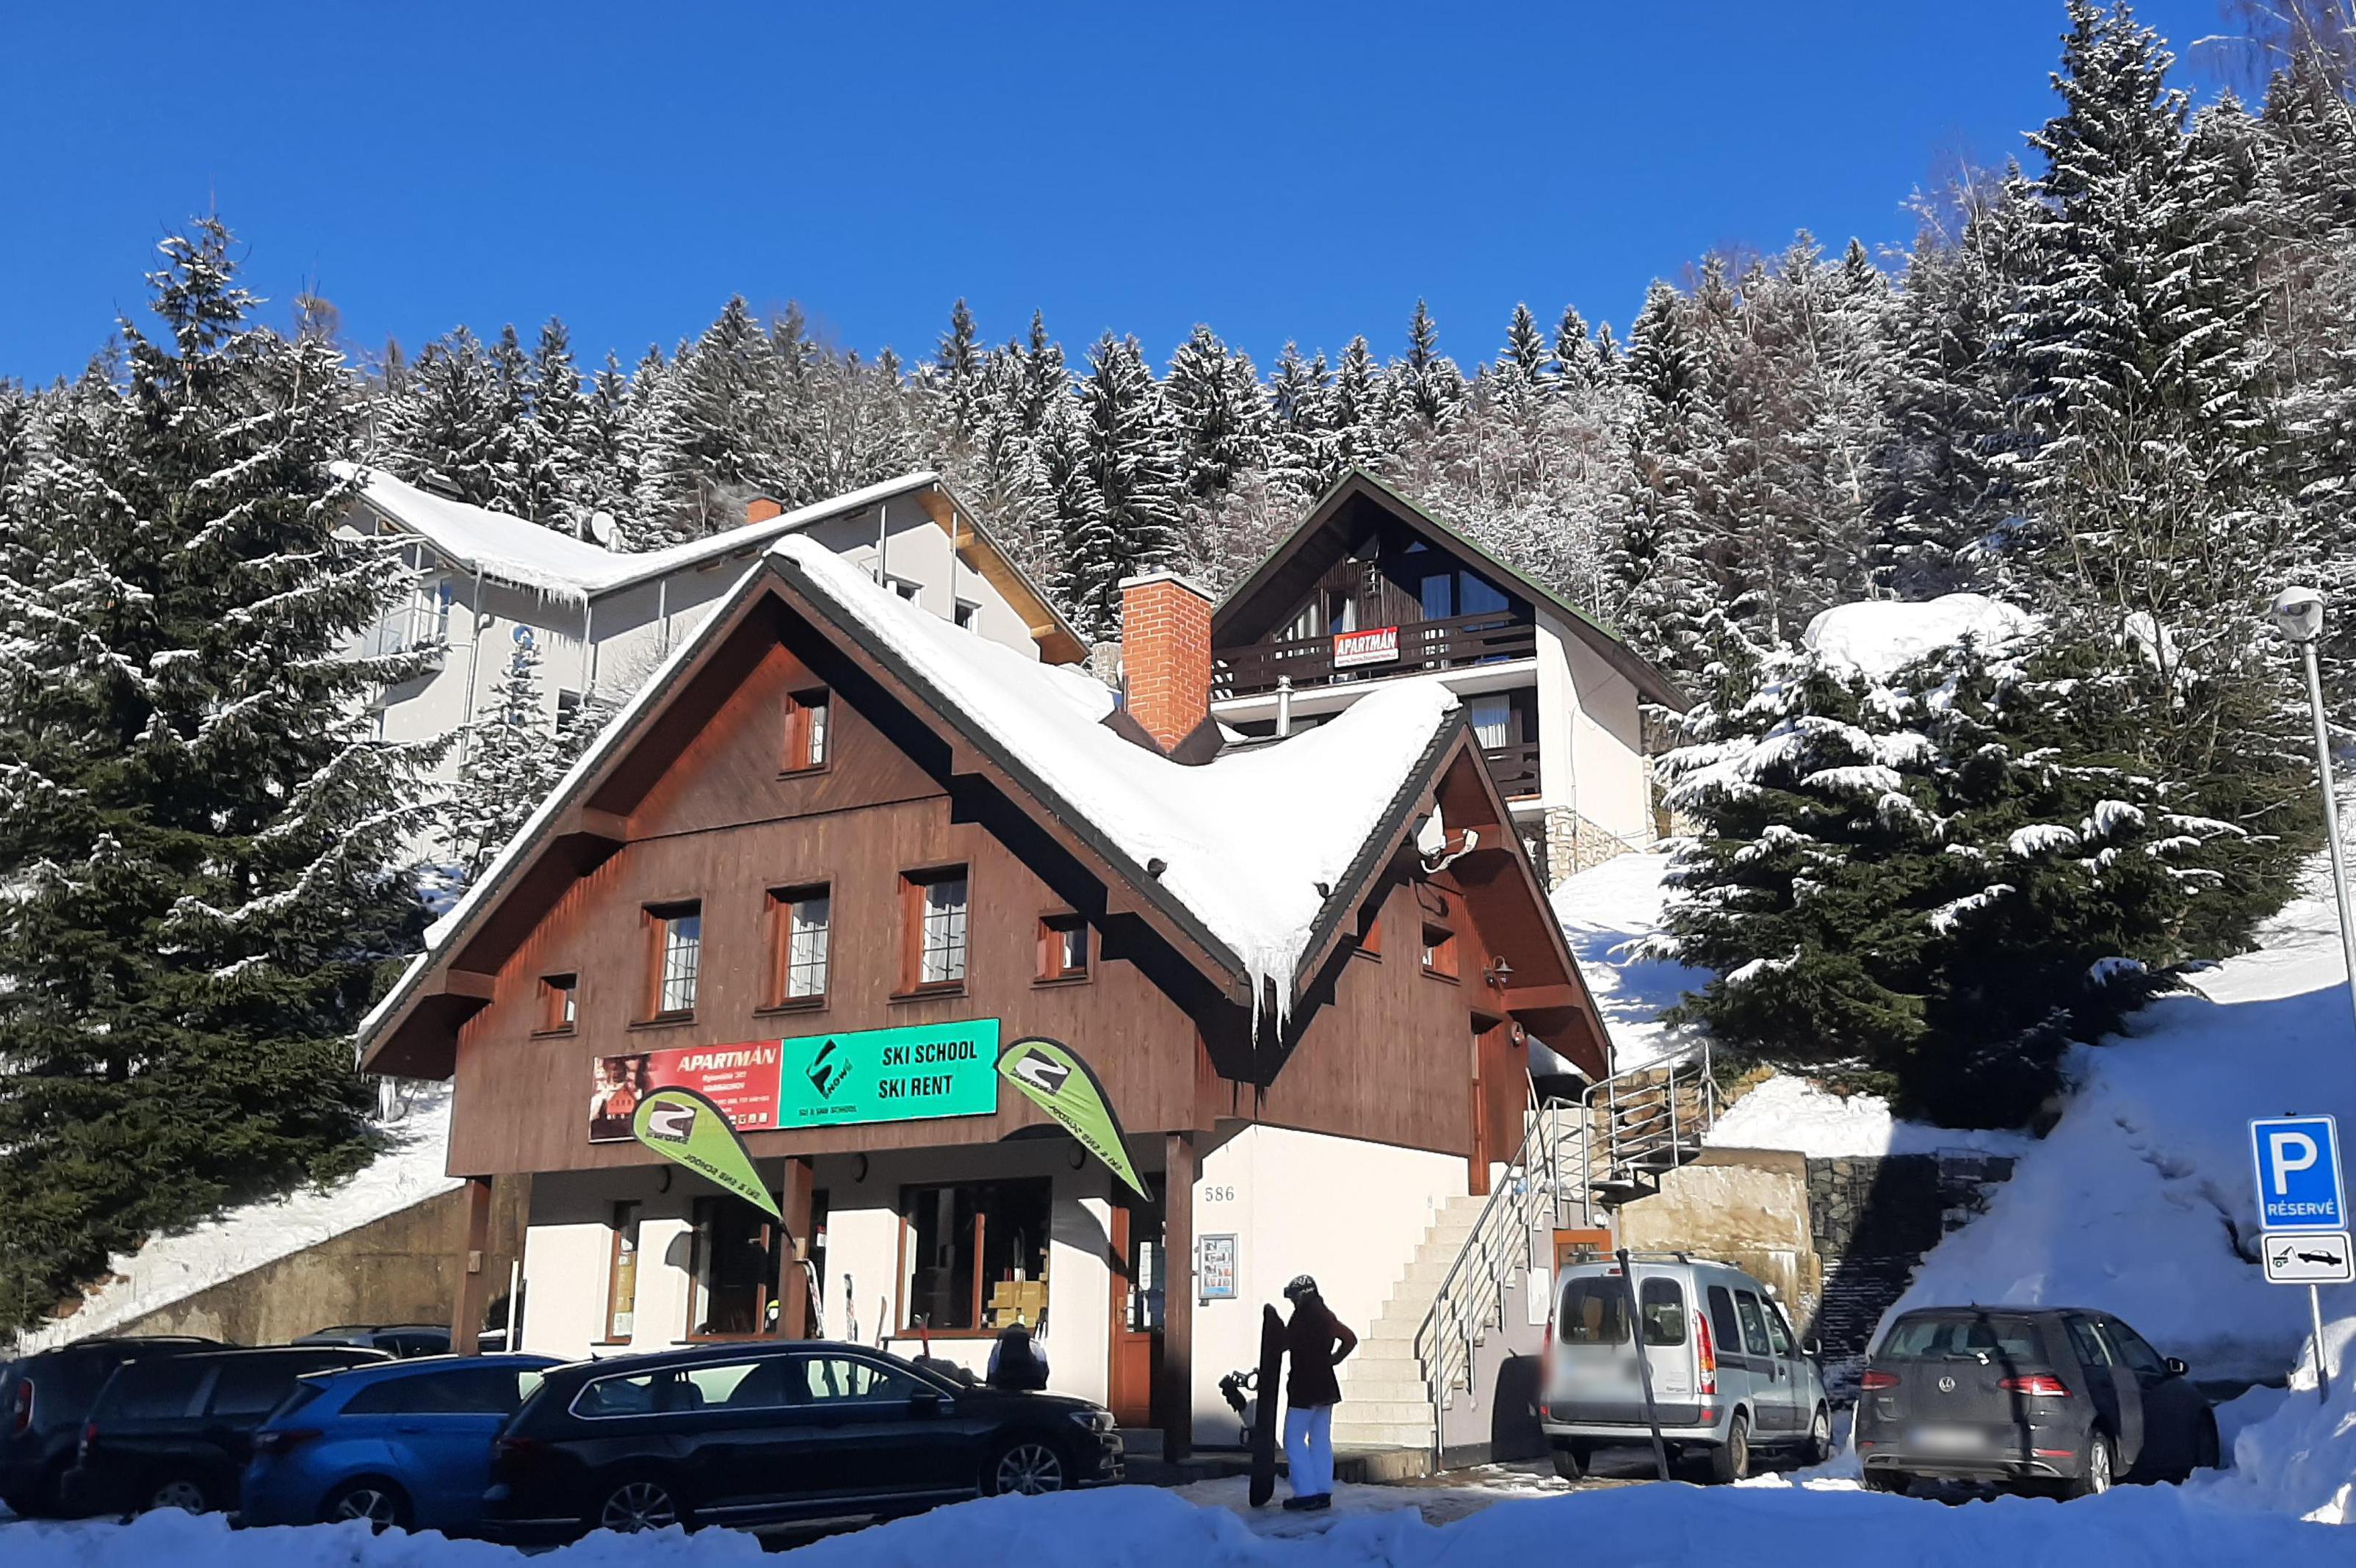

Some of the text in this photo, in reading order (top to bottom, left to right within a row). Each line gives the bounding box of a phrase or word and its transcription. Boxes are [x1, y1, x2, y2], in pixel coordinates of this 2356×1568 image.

[1337, 629, 1398, 656] APARTMÁN
[677, 1045, 777, 1072] APARTMÁN
[882, 1041, 978, 1066] SKI SCHOOL
[878, 1075, 954, 1099] SKI RENT
[2269, 1132, 2318, 1196] P
[1205, 1186, 1235, 1202] 586
[2268, 1198, 2336, 1216] RÉSERVÉ
